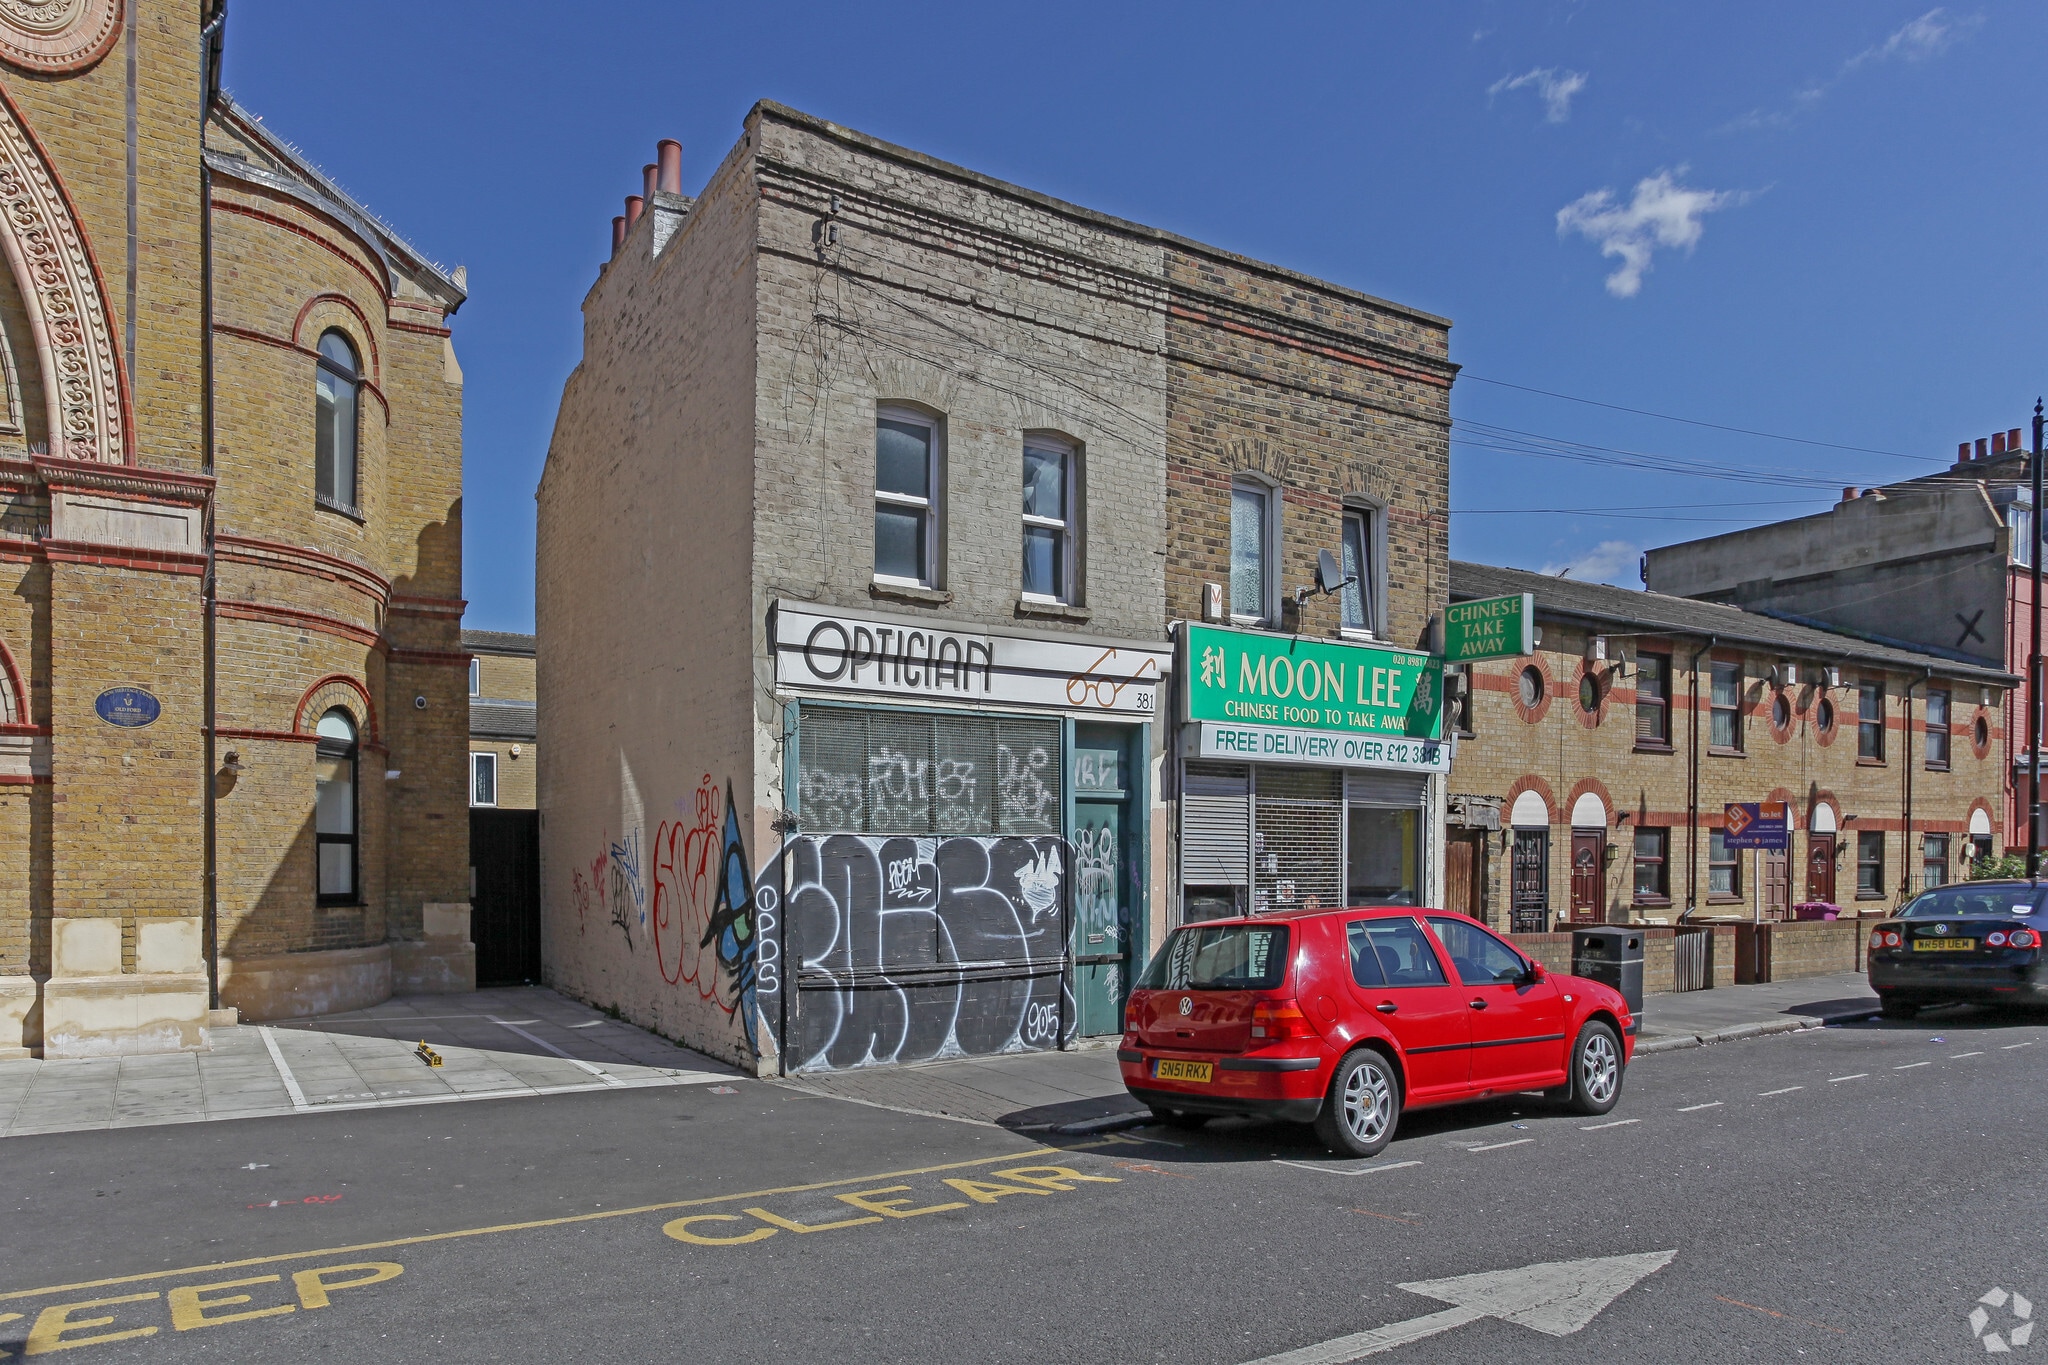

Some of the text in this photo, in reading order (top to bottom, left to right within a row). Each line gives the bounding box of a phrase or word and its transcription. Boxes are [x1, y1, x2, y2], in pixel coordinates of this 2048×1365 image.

[1448, 599, 1519, 622] CHINESE
[1462, 619, 1504, 638] TAKE
[803, 620, 995, 694] OPTICIAN
[1460, 637, 1506, 656] AWAY
[1200, 645, 1227, 689] 利
[1392, 654, 1406, 665] 020
[1407, 657, 1423, 667] 8981
[1238, 652, 1402, 708] MOON LEE
[1136, 692, 1154, 710] 381
[1224, 700, 1410, 731] CHINESE FOOD TO TAKE AWAY
[1216, 730, 1441, 766] FREE DELIVERY OVER £12 381B
[1727, 837, 1753, 845] stephen
[1160, 1061, 1209, 1079] SN51 RKX
[662, 1165, 1123, 1246] CLEAR
